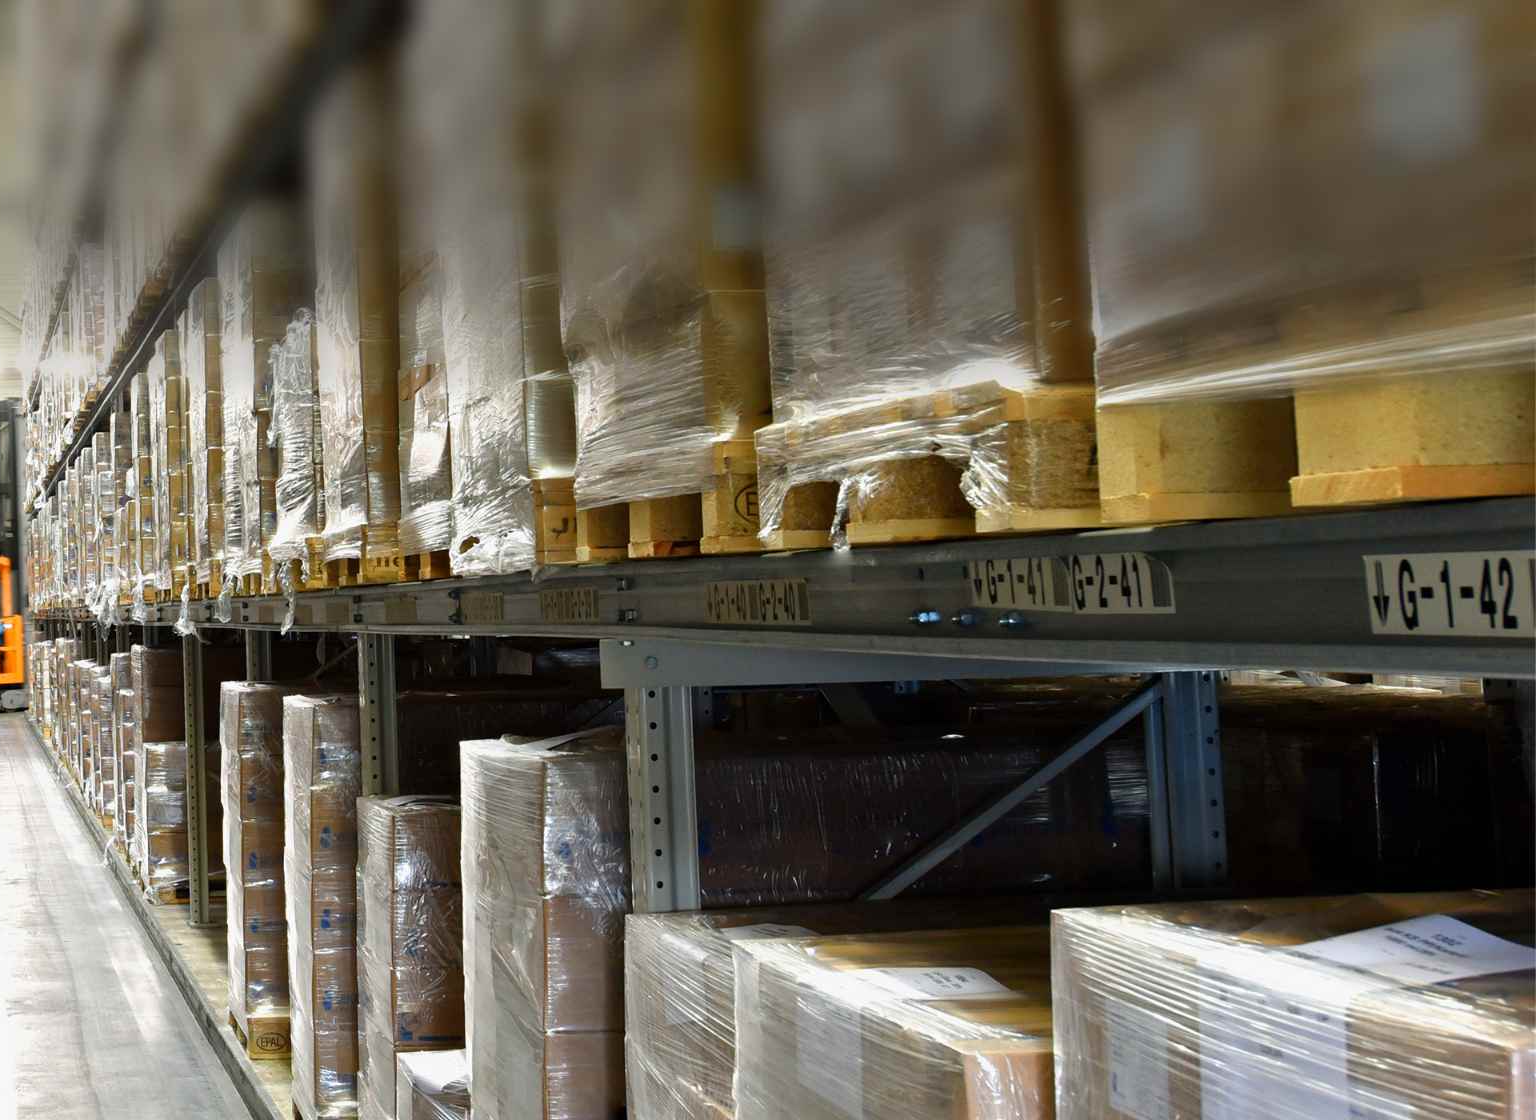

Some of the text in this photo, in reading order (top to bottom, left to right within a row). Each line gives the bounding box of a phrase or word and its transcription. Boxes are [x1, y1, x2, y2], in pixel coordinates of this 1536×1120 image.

[986, 555, 1142, 610] G-1-41 G-2-41
[1398, 558, 1518, 630] G-1-42
